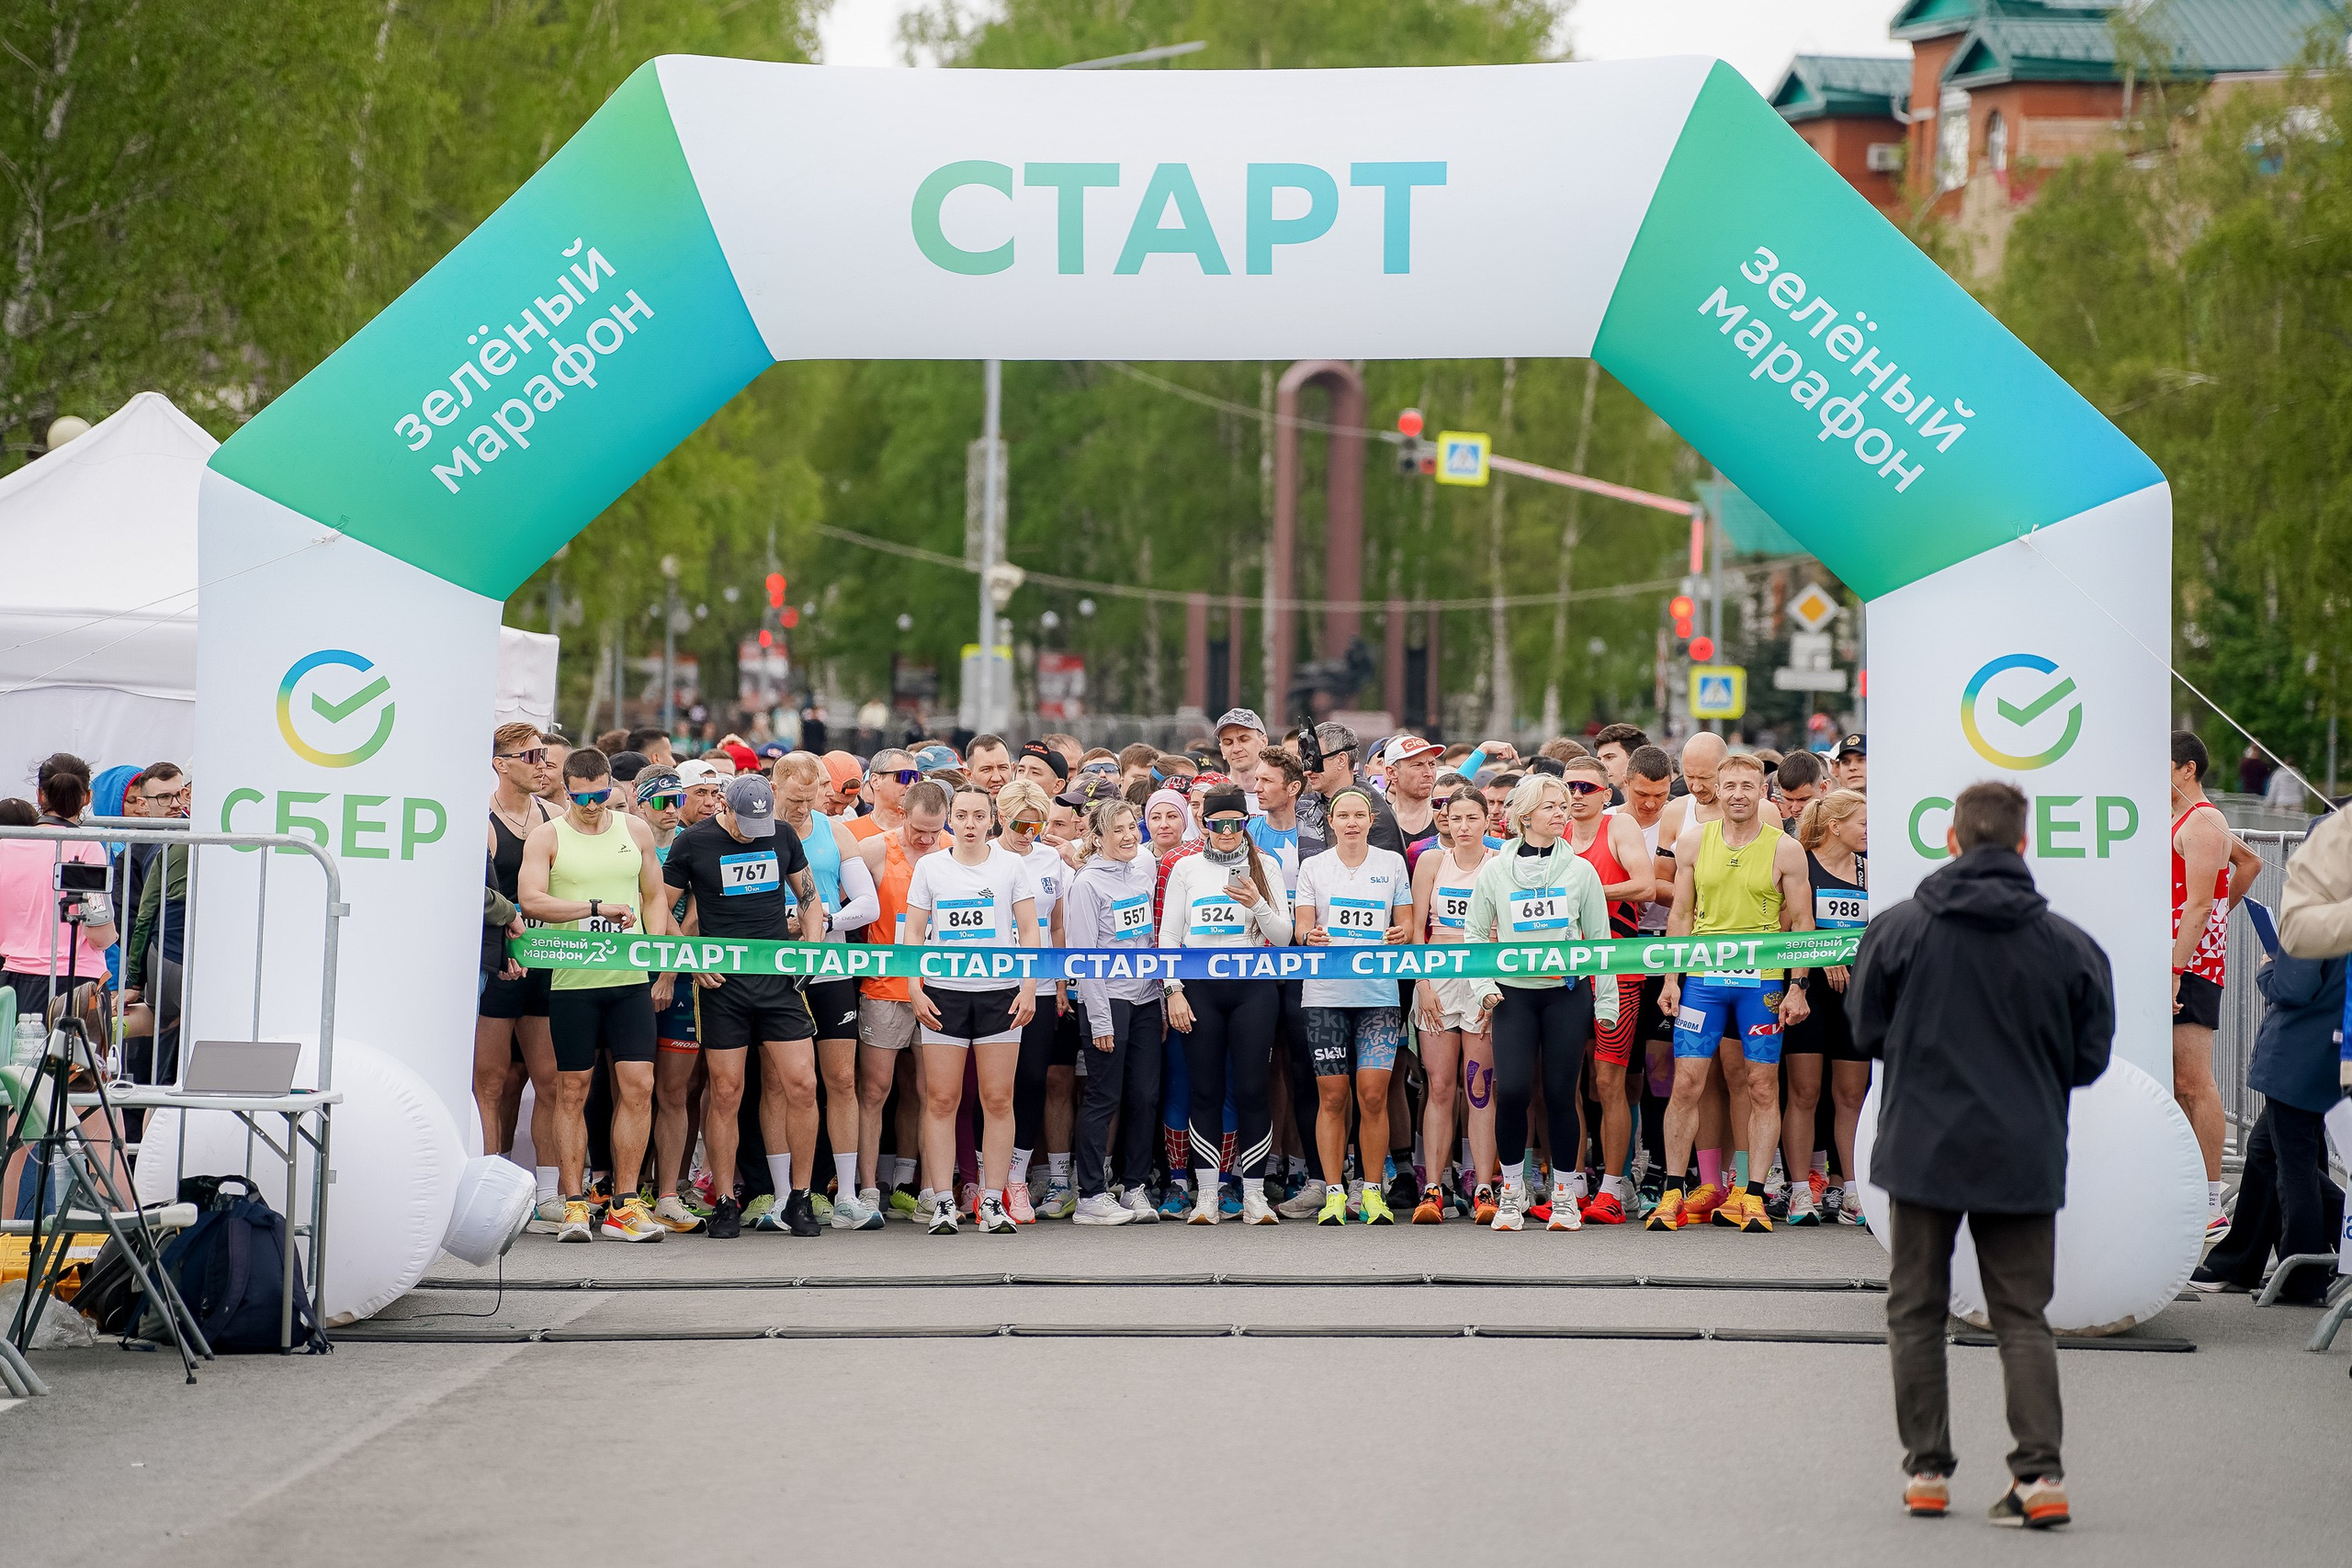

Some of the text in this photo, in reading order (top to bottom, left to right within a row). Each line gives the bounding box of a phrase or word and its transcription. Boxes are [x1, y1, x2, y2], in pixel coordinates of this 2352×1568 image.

[911, 160, 1447, 276] СТАРТ
[393, 237, 616, 451] зелёный
[1739, 245, 1976, 454] зелёный
[430, 288, 655, 494] марафон
[1697, 285, 1926, 494] марафон
[220, 787, 447, 861] СБЕР
[1908, 795, 2139, 861] СЕР
[732, 863, 766, 882] 767
[1124, 907, 1145, 926] 557
[1201, 907, 1235, 922] 524
[1447, 900, 1468, 916] 58
[1522, 900, 1555, 919] 681
[1828, 900, 1860, 917] 988
[949, 910, 983, 927] 848
[1340, 909, 1374, 927] 813
[531, 936, 588, 950] зелёный
[1785, 935, 1843, 949] зелёный
[523, 948, 583, 961] марафон
[628, 941, 1763, 978] СТАРТ СТАРТ СТАРТ СТАРТ СТАРТ СТАРТ СТАРТ СТАРТ
[1777, 947, 1837, 961] марафон
